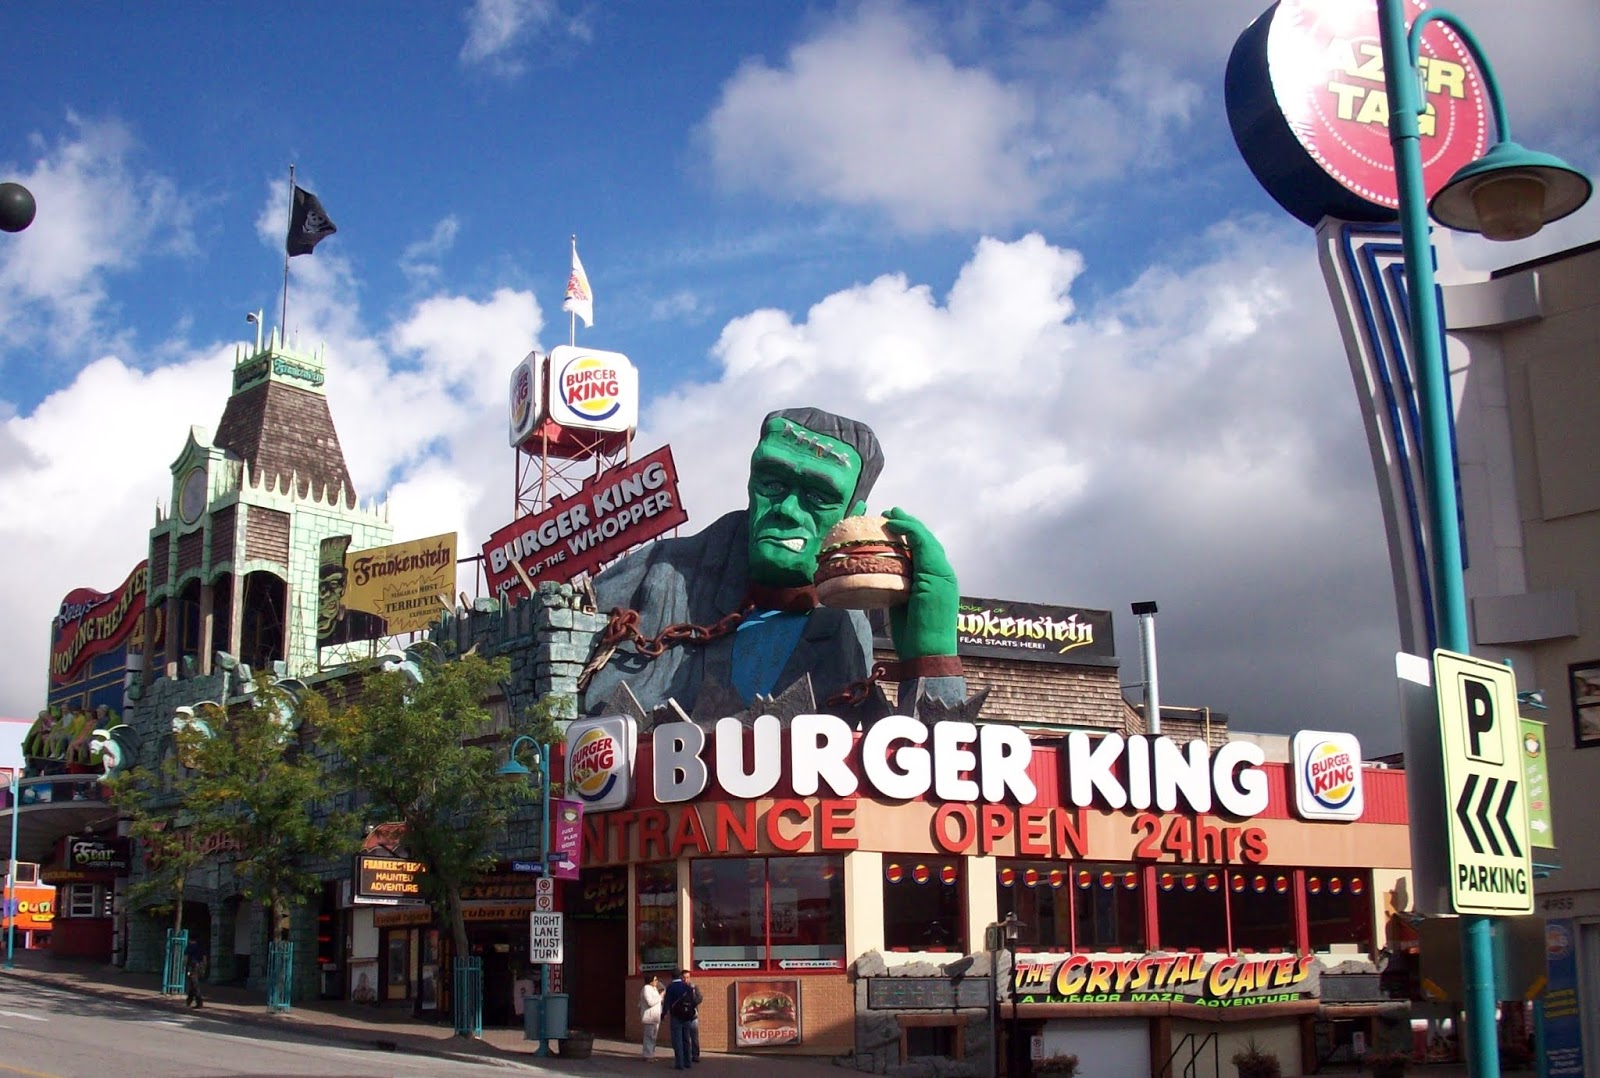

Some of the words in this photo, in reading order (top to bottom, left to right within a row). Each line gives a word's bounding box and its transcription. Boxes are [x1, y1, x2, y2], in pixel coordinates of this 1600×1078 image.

[566, 369, 616, 387] BURGER
[567, 381, 619, 404] KING
[490, 502, 590, 574] BURGER
[593, 462, 667, 518] KING
[495, 572, 521, 595] HOM
[528, 563, 544, 577] OF
[544, 550, 566, 568] THE
[567, 491, 673, 556] WHOPPER
[353, 540, 450, 586] Frankenstein
[420, 584, 437, 592] MOST
[385, 594, 447, 613] TERRIFYIN
[54, 616, 95, 675] MOVING
[959, 636, 983, 645] FEAR
[985, 638, 1018, 647] STARTS
[1019, 642, 1046, 650] HERE!
[1463, 679, 1494, 756] P
[572, 737, 613, 767] BURGER
[653, 714, 1036, 804] BURGER
[1069, 732, 1268, 817] KING
[1312, 753, 1350, 776] BURGER
[1314, 765, 1353, 795] KING
[581, 800, 859, 864] NTRANCE
[935, 802, 1088, 857] OPEN
[1136, 814, 1268, 863] 24hrs
[73, 841, 115, 864] Fear
[370, 882, 418, 892] ADVENTURE
[376, 873, 414, 882] HAUNTED
[1458, 864, 1527, 895] PARKING
[534, 916, 560, 925] RIGHT
[535, 928, 558, 936] LANE
[534, 939, 560, 948] MUST
[534, 950, 559, 959] TURN
[1014, 963, 1051, 988] THE
[1057, 953, 1207, 996] CRYSTAL
[1209, 956, 1314, 996] CAVES
[1021, 995, 1035, 1003] A
[1132, 993, 1185, 1003] MAZE
[1195, 993, 1299, 1007] ADVENTURE
[742, 1030, 796, 1039] WHOPPER
